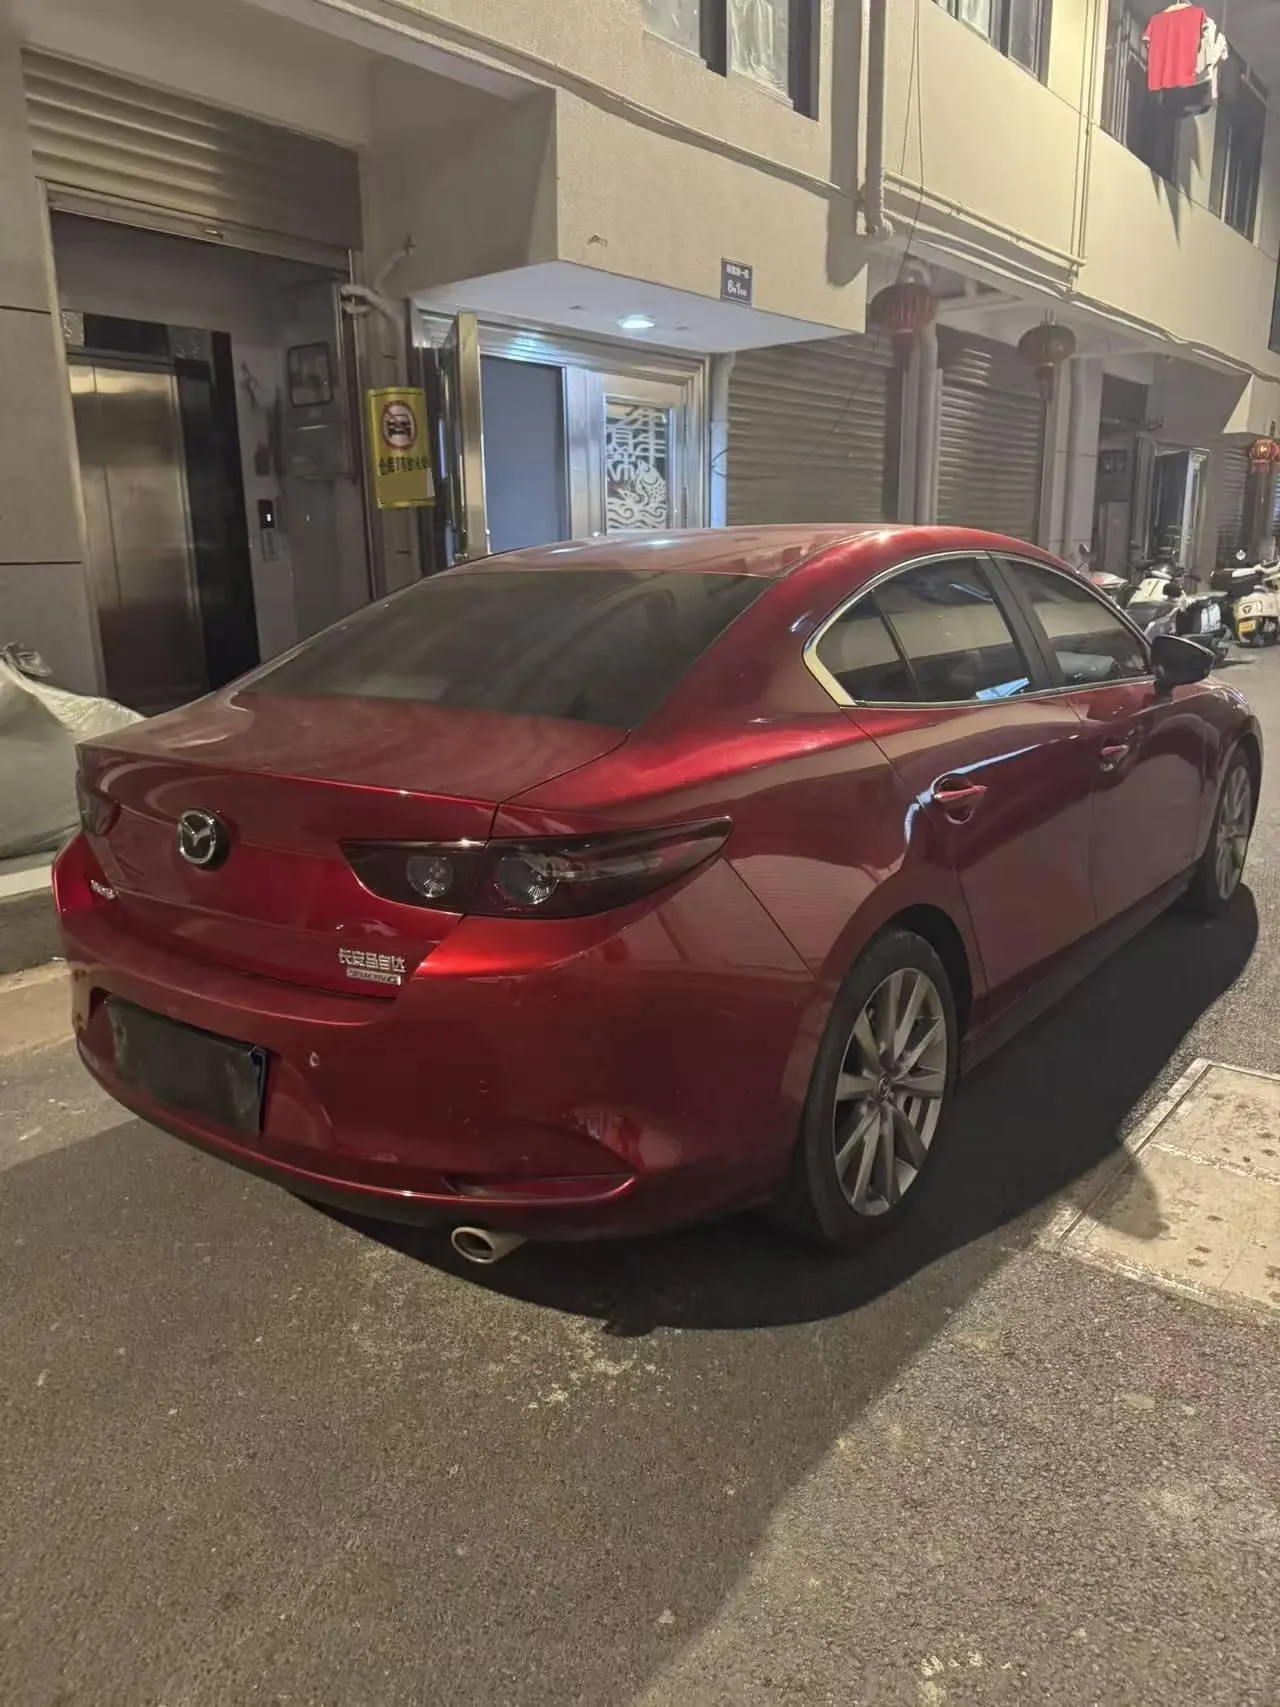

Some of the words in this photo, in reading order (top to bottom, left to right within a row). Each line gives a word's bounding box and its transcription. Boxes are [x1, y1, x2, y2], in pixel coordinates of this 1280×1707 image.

[339, 947, 406, 972] 长安马自达
